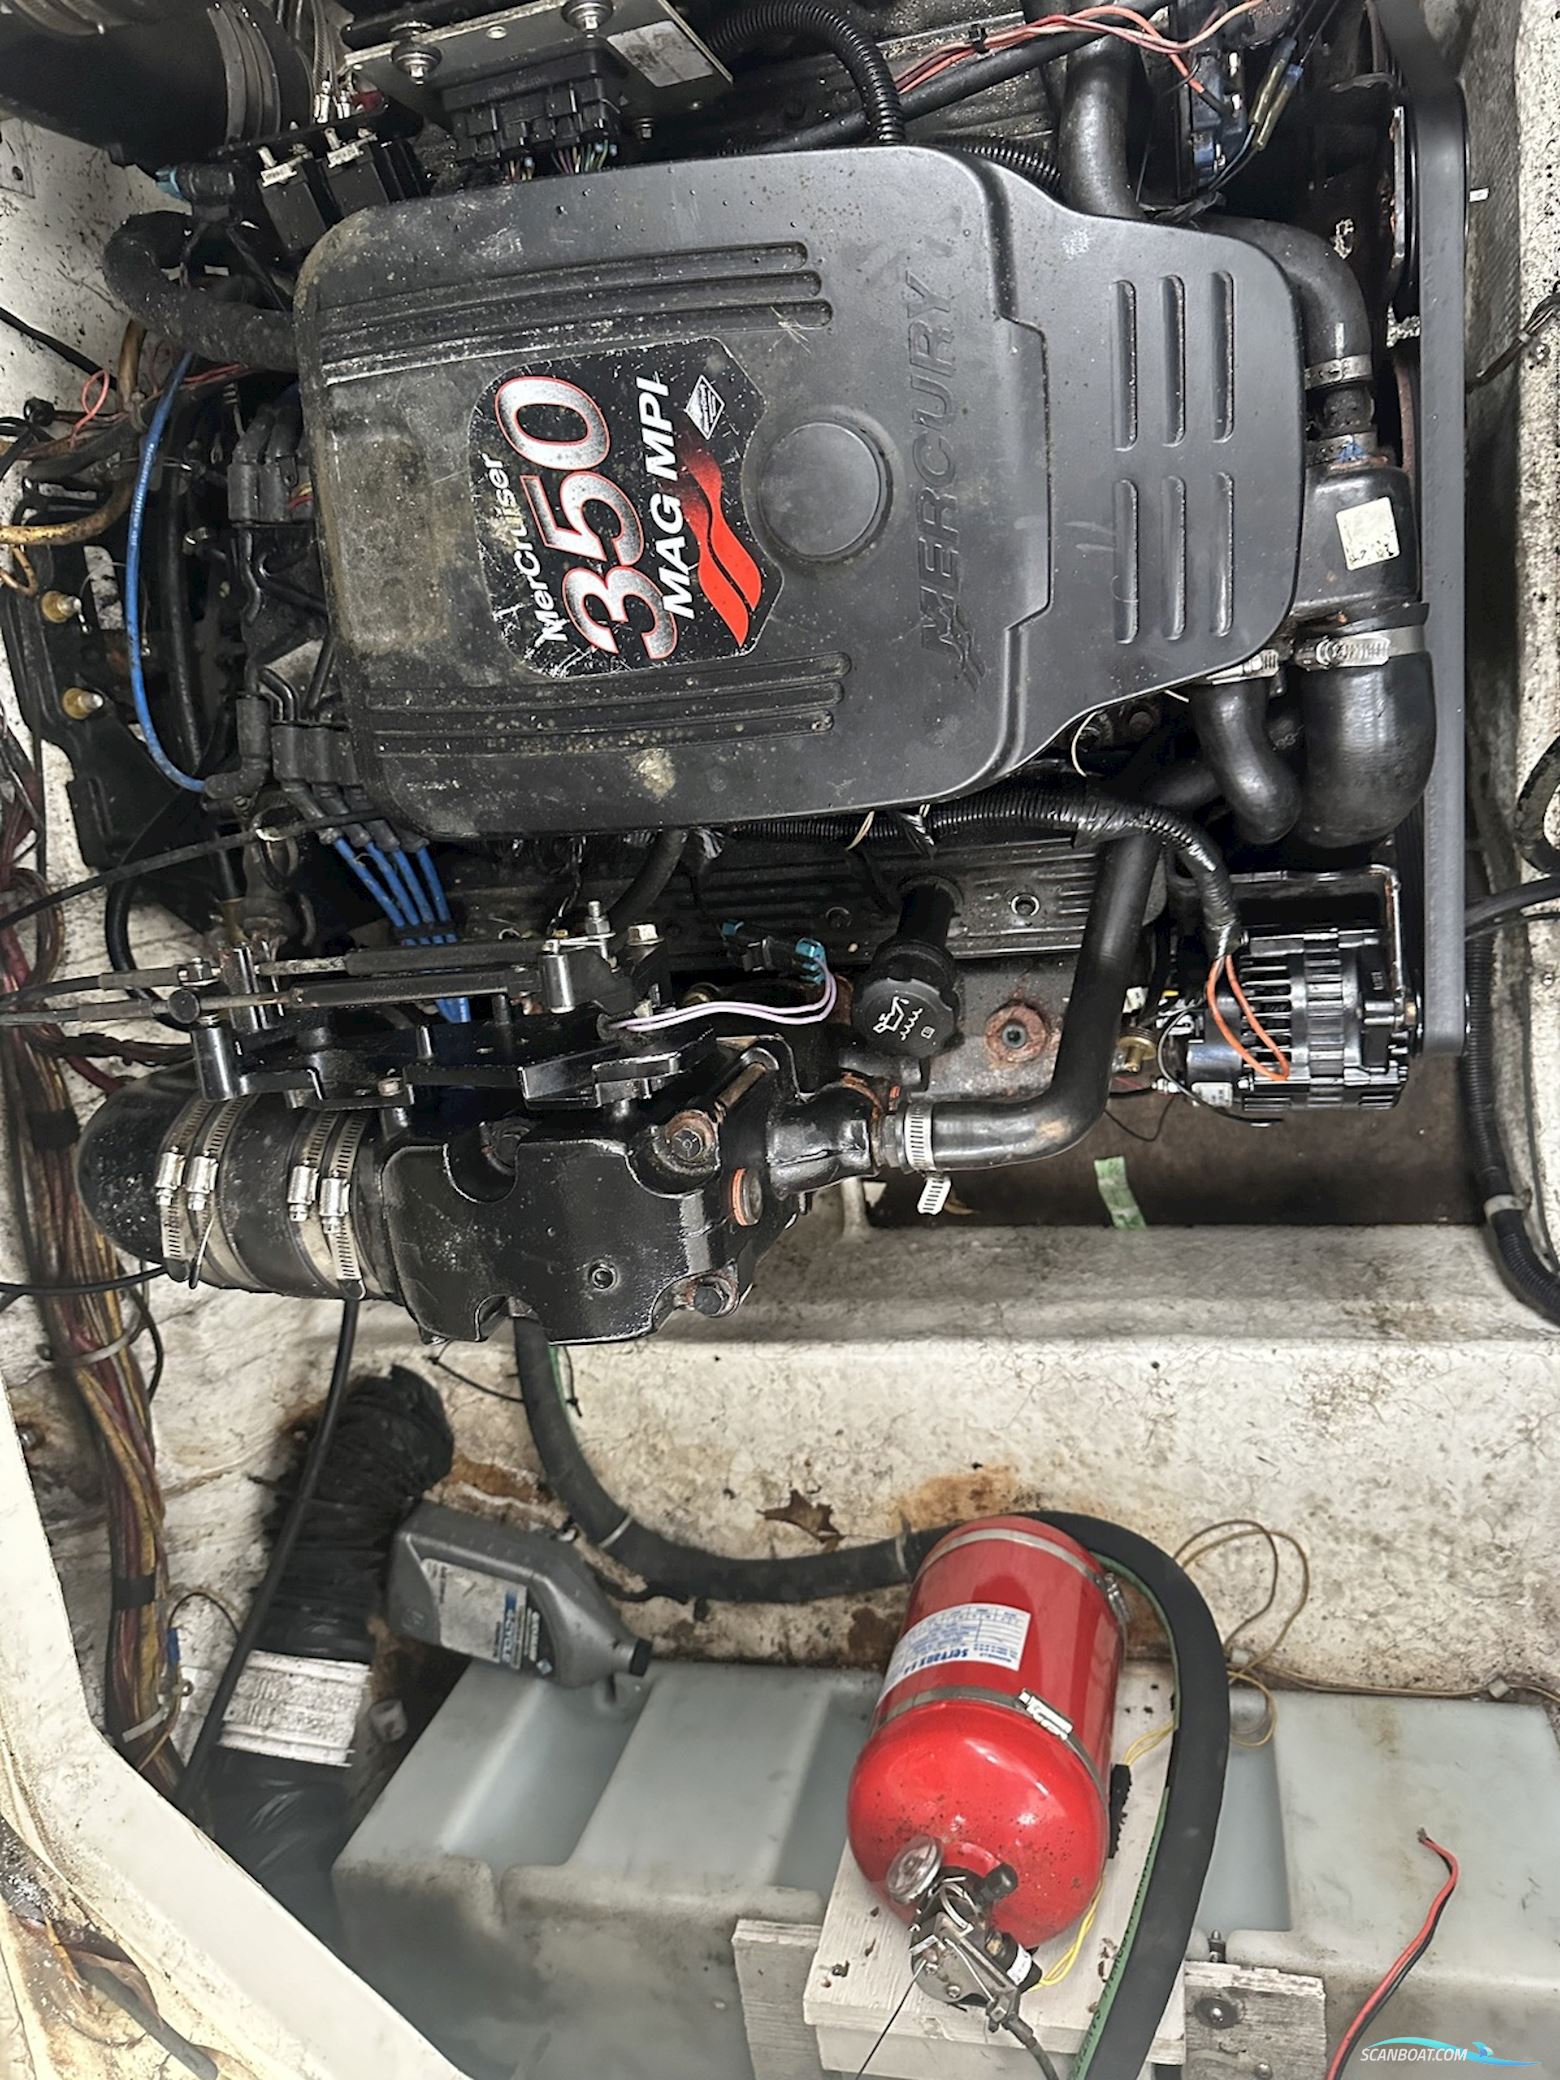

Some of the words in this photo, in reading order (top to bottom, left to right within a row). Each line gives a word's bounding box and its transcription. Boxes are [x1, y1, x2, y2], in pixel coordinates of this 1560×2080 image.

[495, 375, 679, 660] 350
[636, 375, 678, 482] MPI
[905, 269, 985, 693] MERCURY
[479, 452, 569, 643] MerCruiser
[650, 492, 696, 619] MAG
